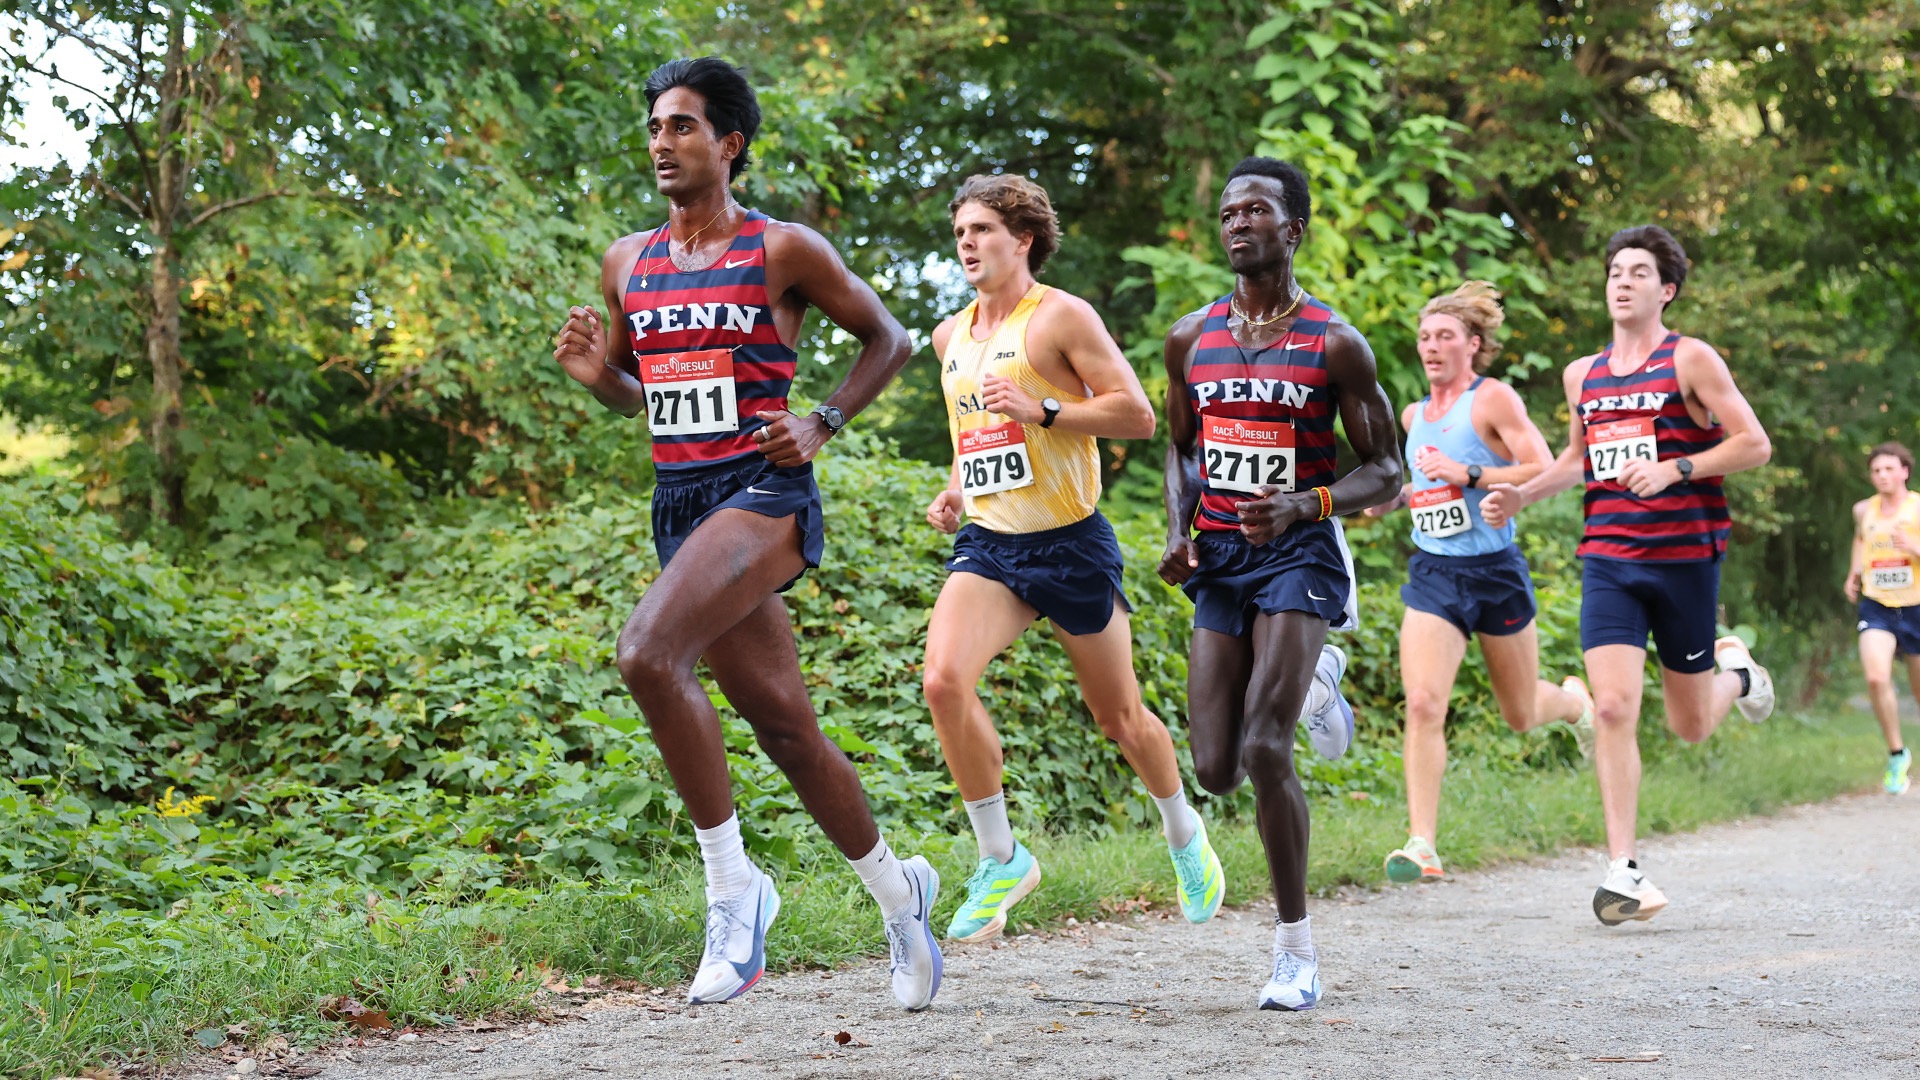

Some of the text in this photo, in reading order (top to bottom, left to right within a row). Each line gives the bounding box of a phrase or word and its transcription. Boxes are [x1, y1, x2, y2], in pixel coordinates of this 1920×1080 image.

[629, 302, 762, 341] PENN
[650, 359, 715, 374] RACE RESULT
[651, 386, 724, 425] 2711
[1194, 377, 1314, 409] PENN
[1582, 391, 1669, 419] PENN
[982, 430, 1009, 443] RESULT
[1213, 425, 1278, 440] RACE RESULT
[963, 451, 1025, 489] 2679
[1207, 448, 1288, 485] 2712
[1416, 506, 1464, 532] 2729
